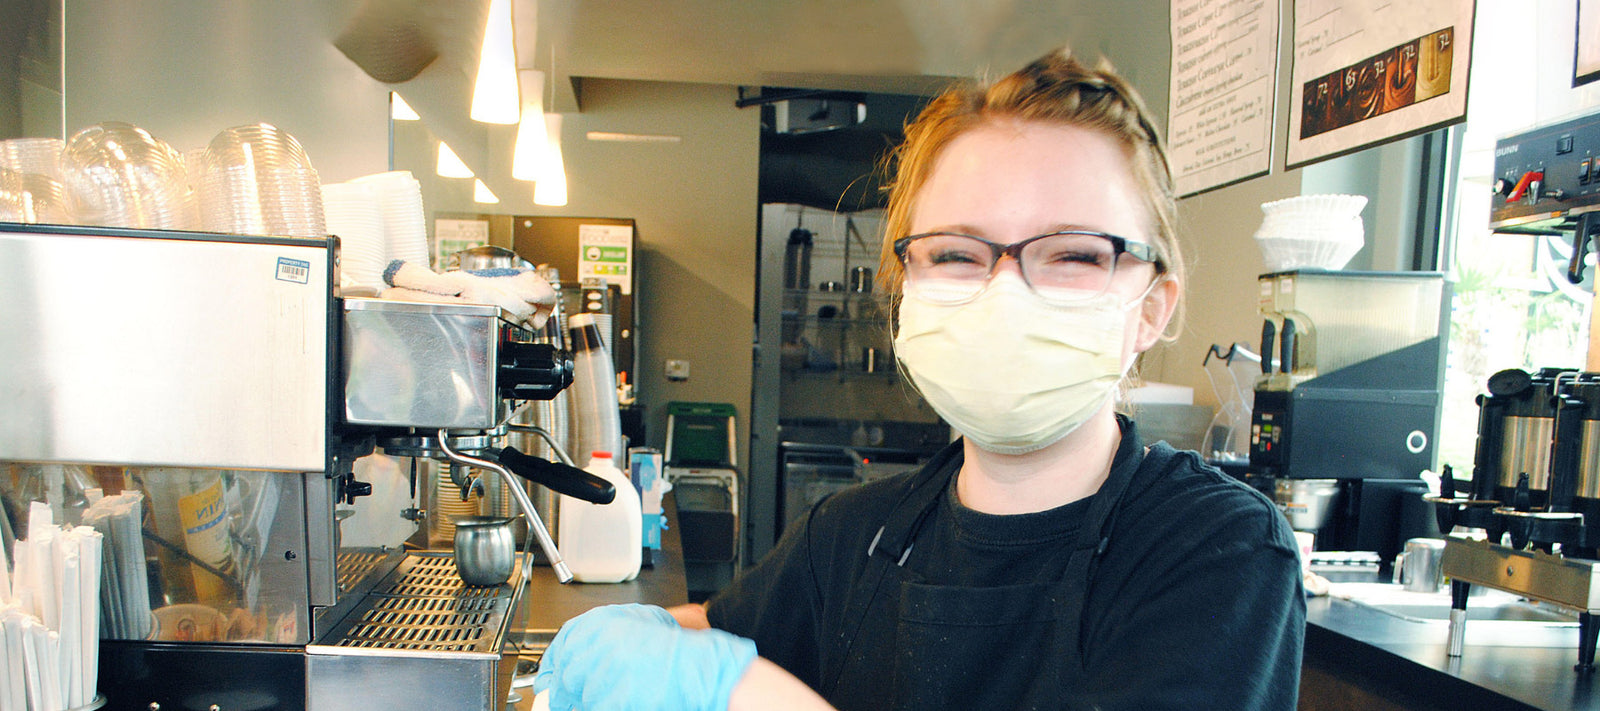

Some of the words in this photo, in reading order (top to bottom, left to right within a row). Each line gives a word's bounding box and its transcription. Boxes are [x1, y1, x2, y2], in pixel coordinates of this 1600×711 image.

[1317, 82, 1328, 100] 72
[1345, 69, 1357, 91] 63
[1496, 144, 1519, 157] BUNN
